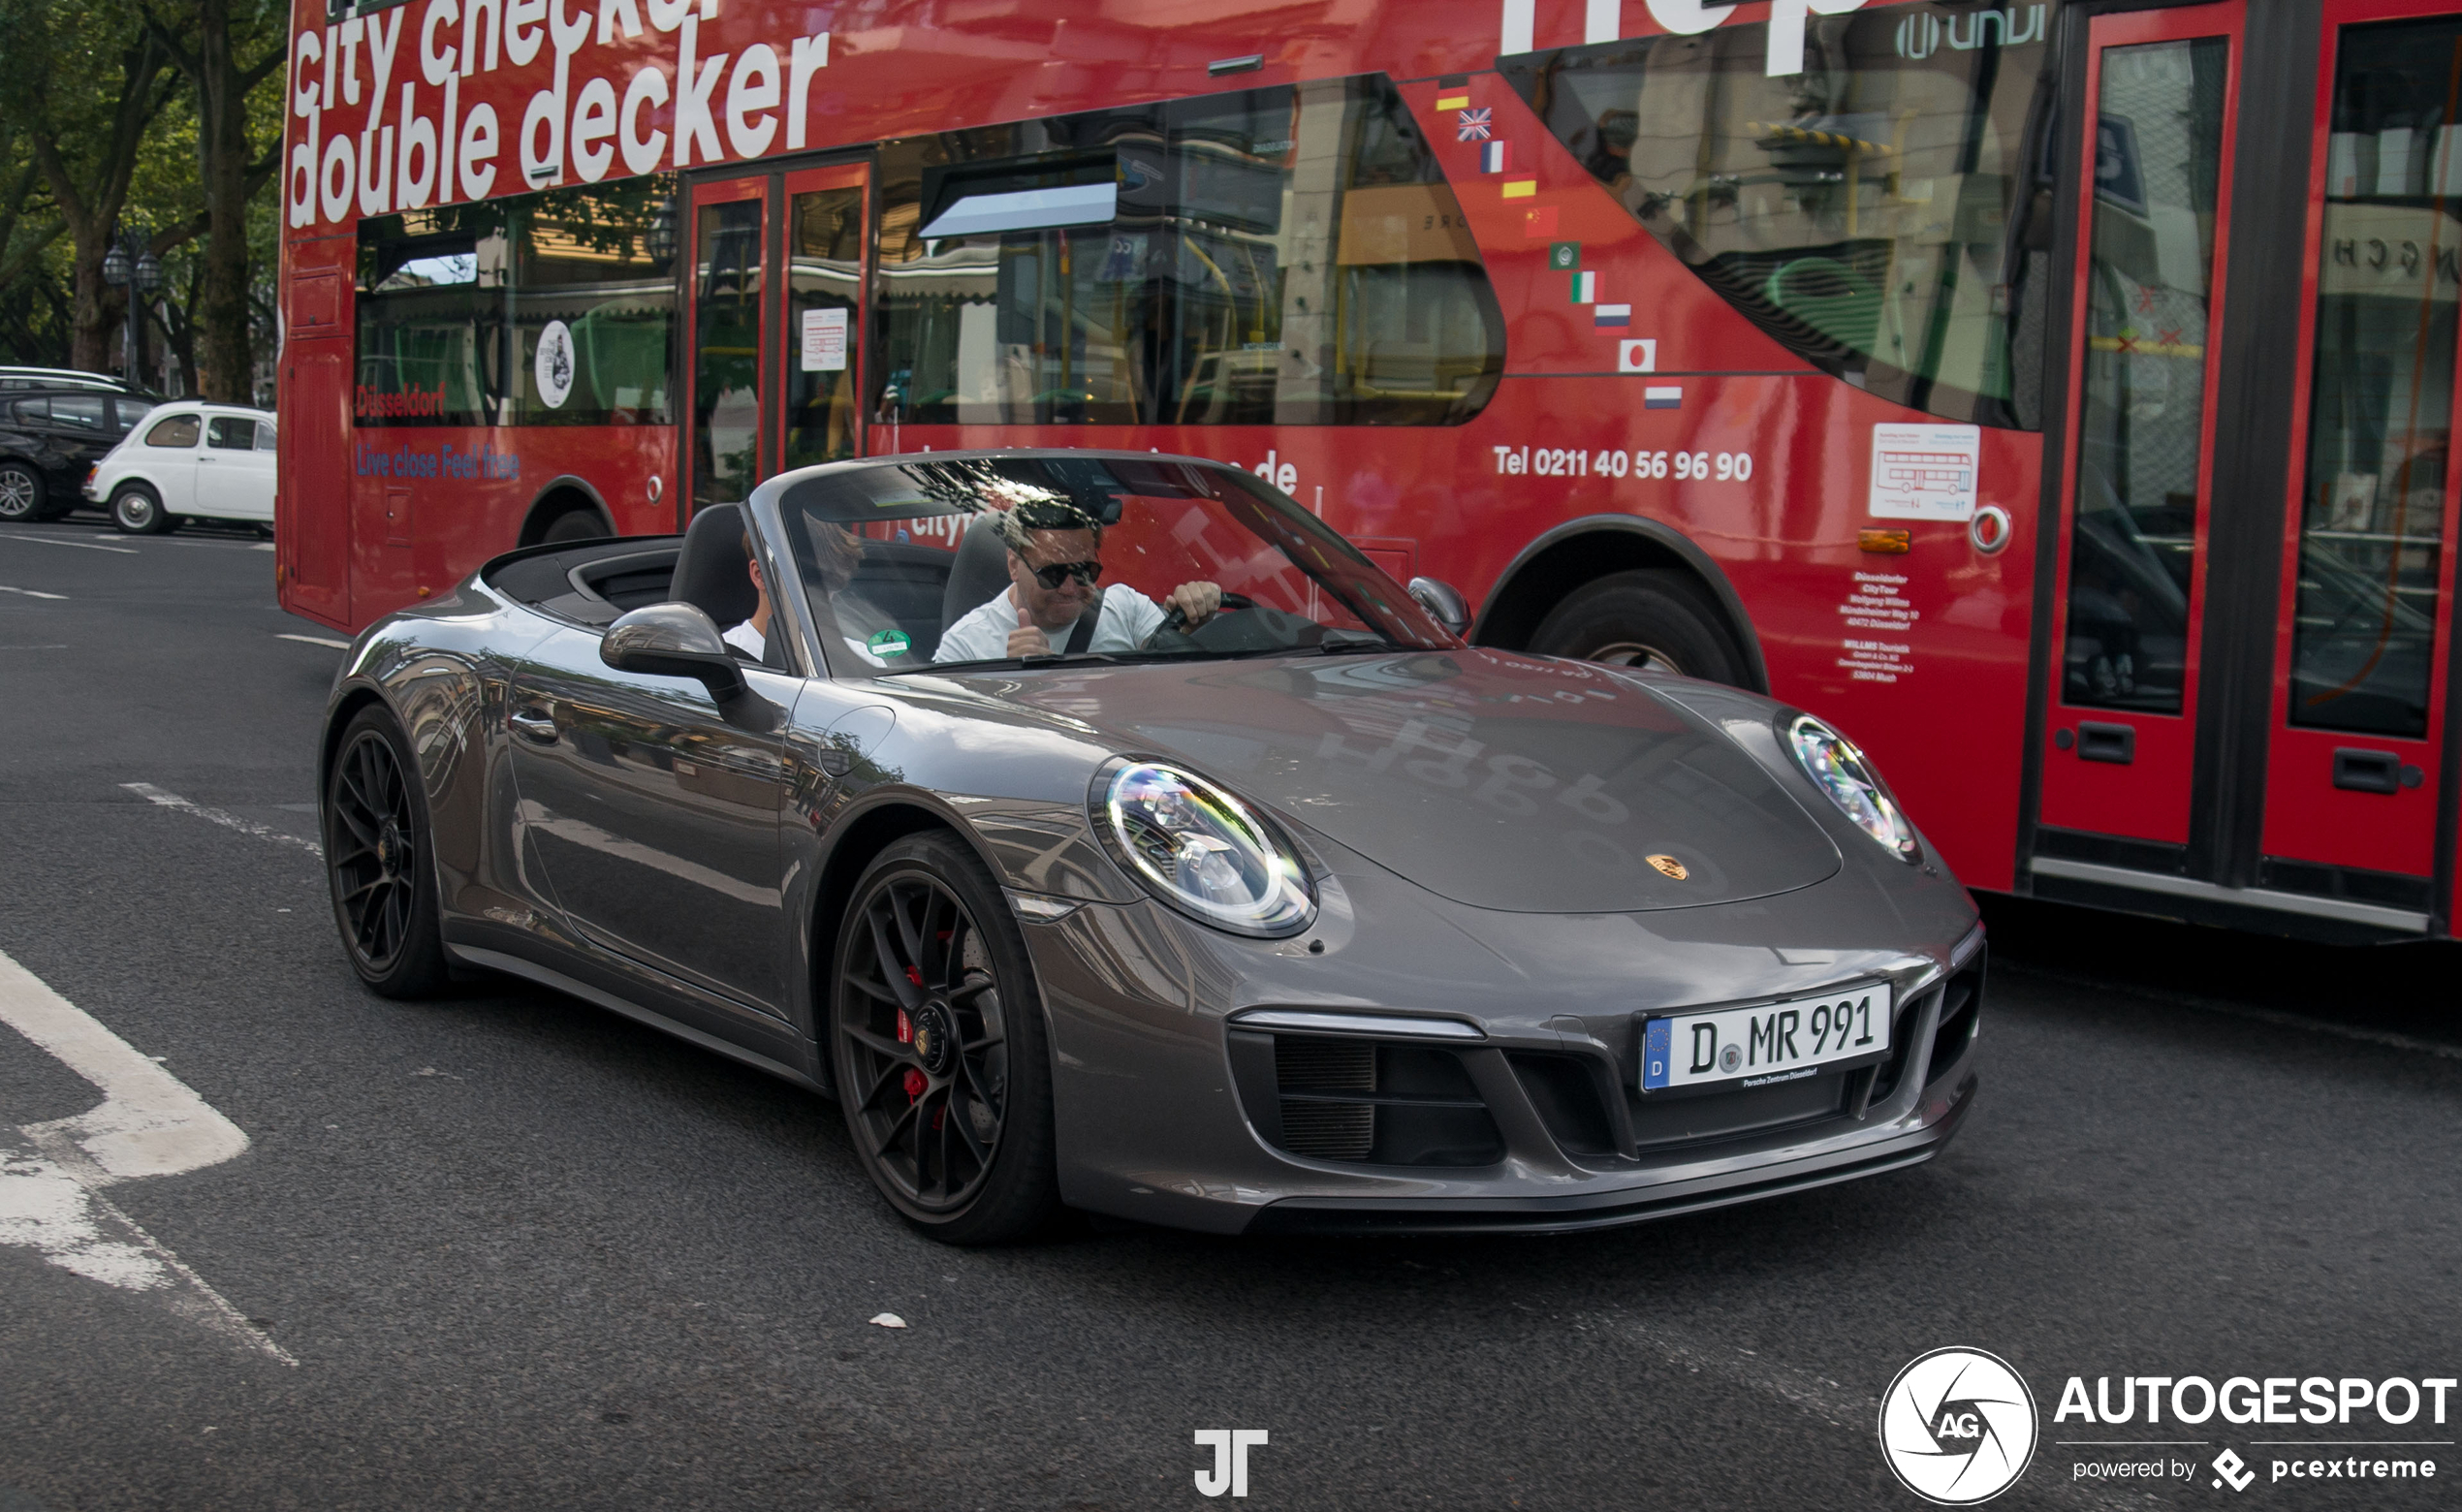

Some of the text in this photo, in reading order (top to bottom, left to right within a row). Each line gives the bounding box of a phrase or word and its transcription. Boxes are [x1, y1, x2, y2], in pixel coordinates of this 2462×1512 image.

[294, 6, 405, 132] city
[291, 14, 831, 230] double decker
[356, 381, 446, 417] Düsseldorf
[357, 444, 520, 480] Live close Feel free
[1494, 446, 1752, 482] Tel 0211 40 56 96 90
[1689, 994, 1875, 1075] D MR 991
[1651, 1060, 1663, 1077] D
[1743, 1067, 1818, 1088] Porsche Zentrum Düsseldorf
